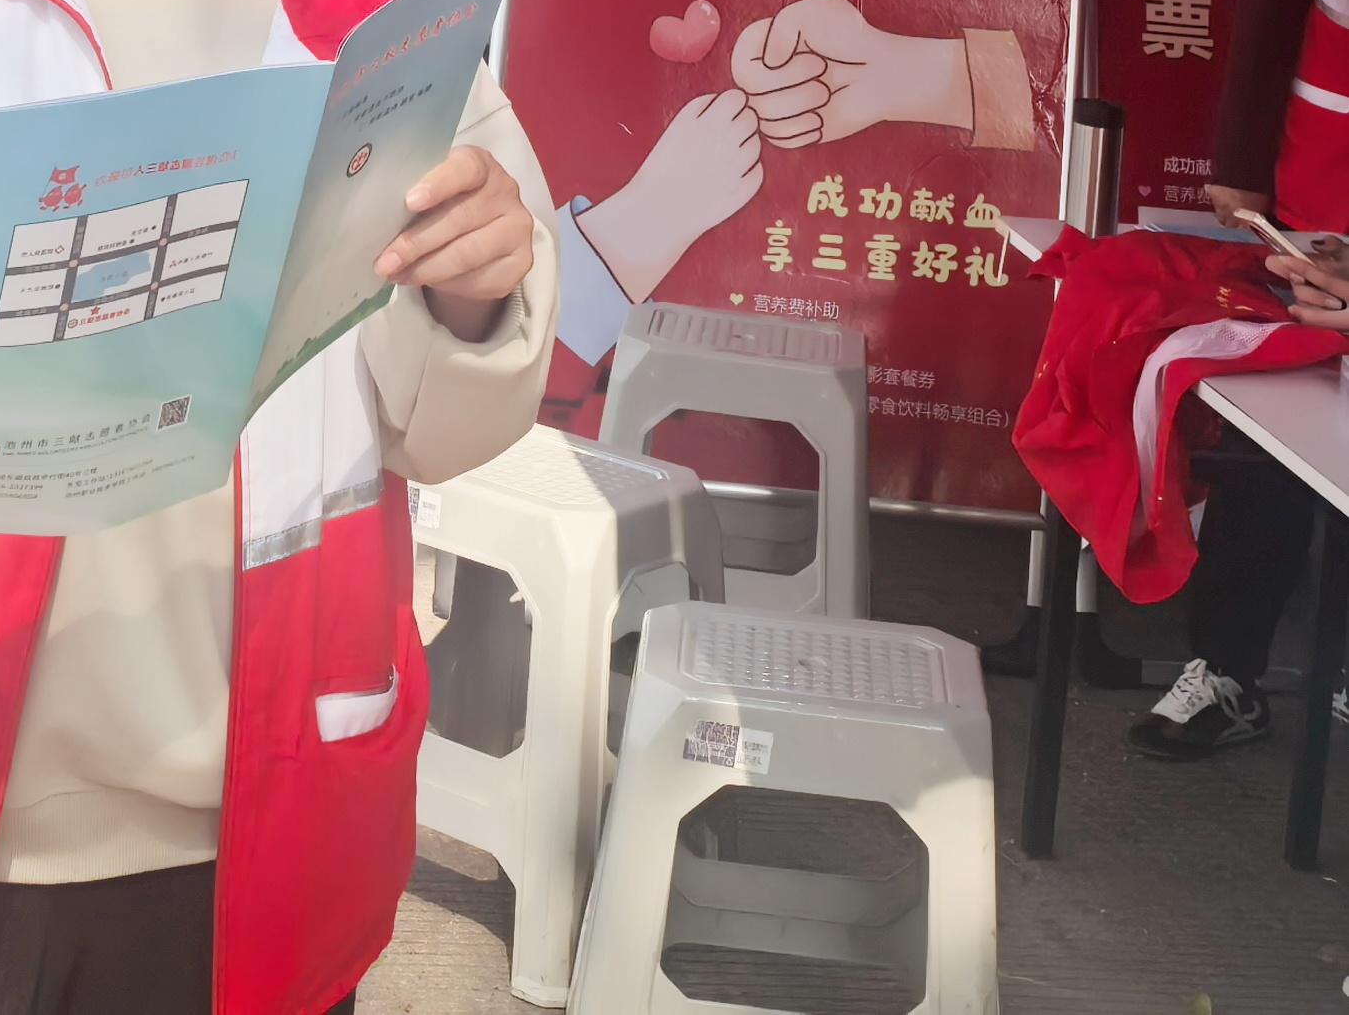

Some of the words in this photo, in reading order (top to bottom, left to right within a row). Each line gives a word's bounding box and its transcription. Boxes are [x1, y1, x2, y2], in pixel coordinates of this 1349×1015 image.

[807, 174, 1001, 229] 成功献血
[762, 220, 1009, 288] 享三重好礼
[753, 294, 840, 320] 营养费补助
